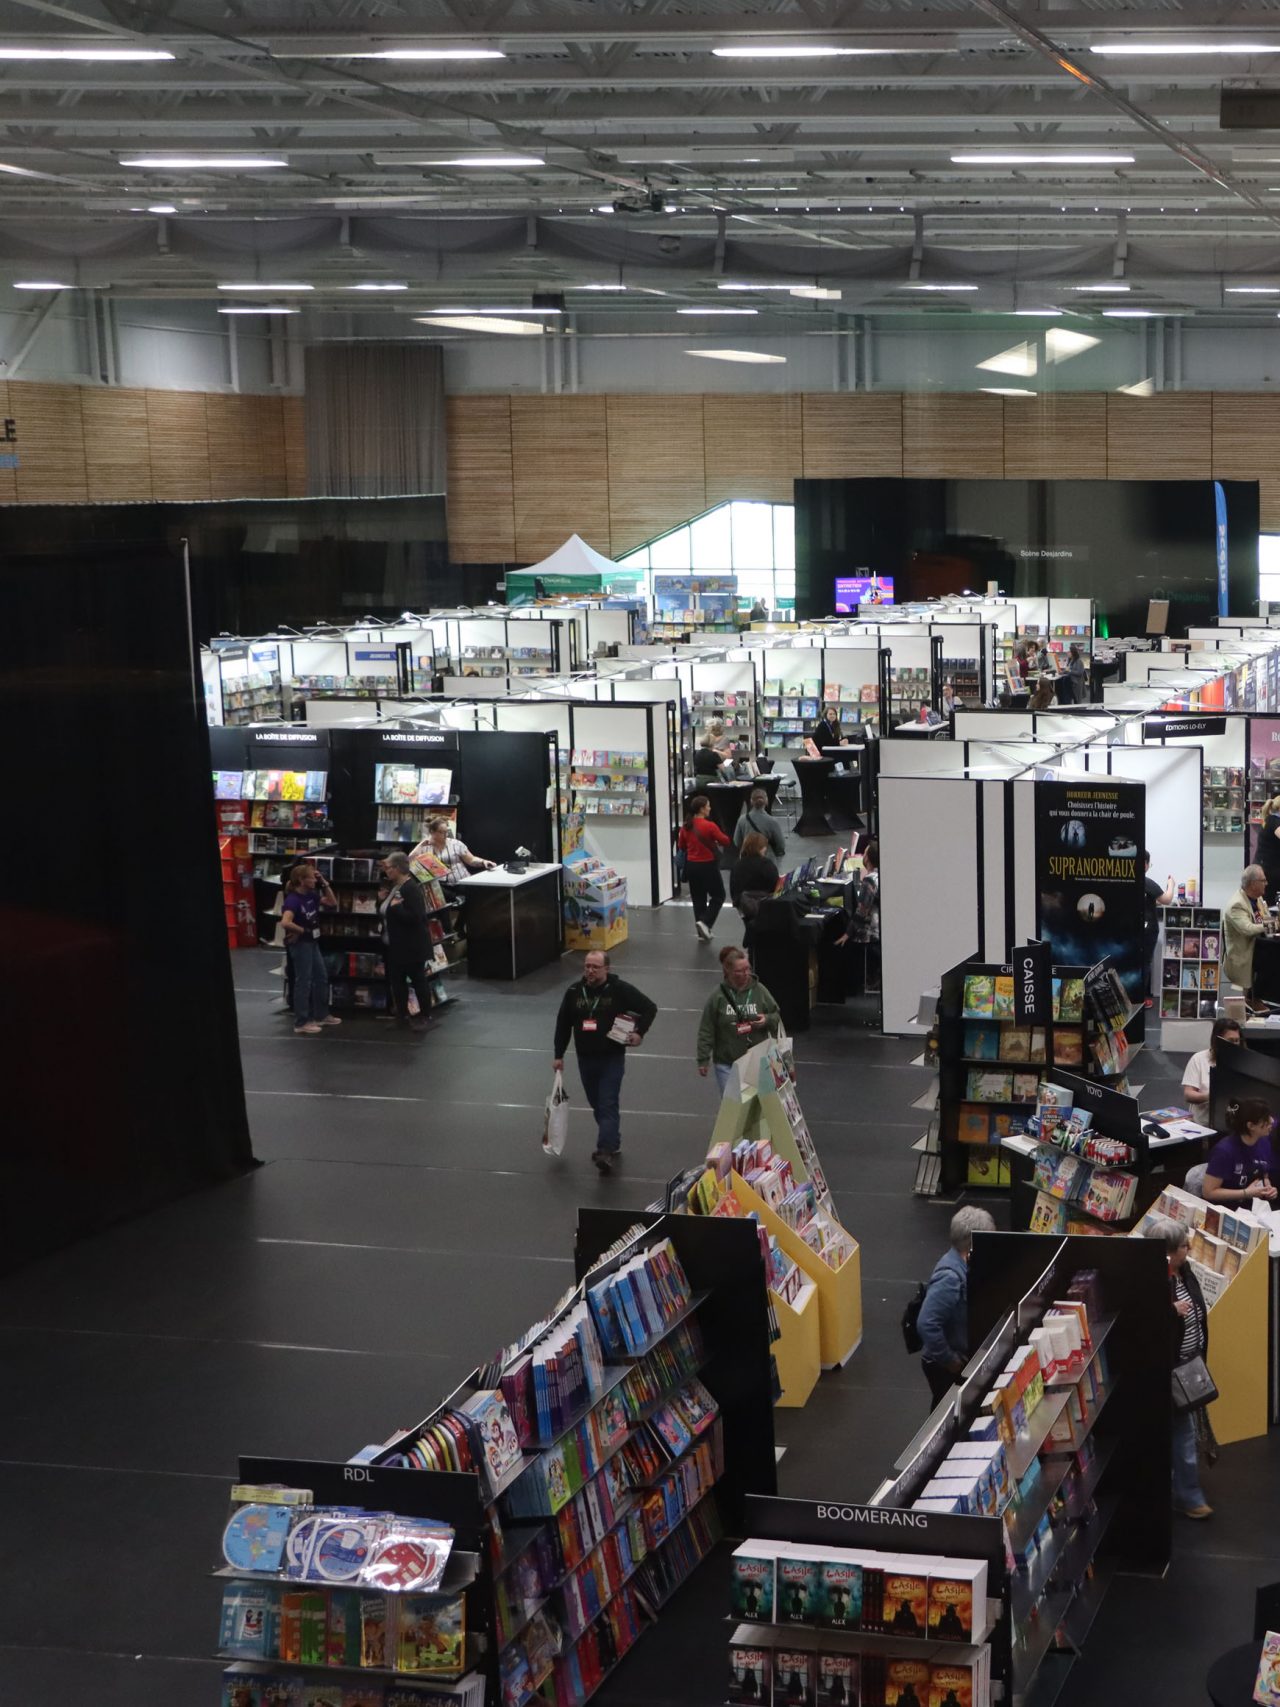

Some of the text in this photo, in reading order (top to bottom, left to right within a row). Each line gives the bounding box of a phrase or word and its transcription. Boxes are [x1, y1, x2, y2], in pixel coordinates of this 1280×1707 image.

[1041, 550, 1073, 559] Desjardins
[264, 732, 280, 740] BOÎTE
[391, 733, 406, 741] BOÎTE
[1066, 791, 1119, 800] HORREUR JEUNESSE
[1067, 801, 1118, 810] Choisissez l'histoire
[1049, 809, 1058, 817] qui
[1098, 810, 1112, 818] chair
[1112, 810, 1119, 818] de
[1049, 856, 1136, 881] SUPRANORMAUX
[1023, 957, 1035, 1015] CAISSE
[1085, 1084, 1103, 1098] YOYO
[343, 1467, 375, 1483] RDL
[817, 1505, 928, 1528] BOOMERANG
